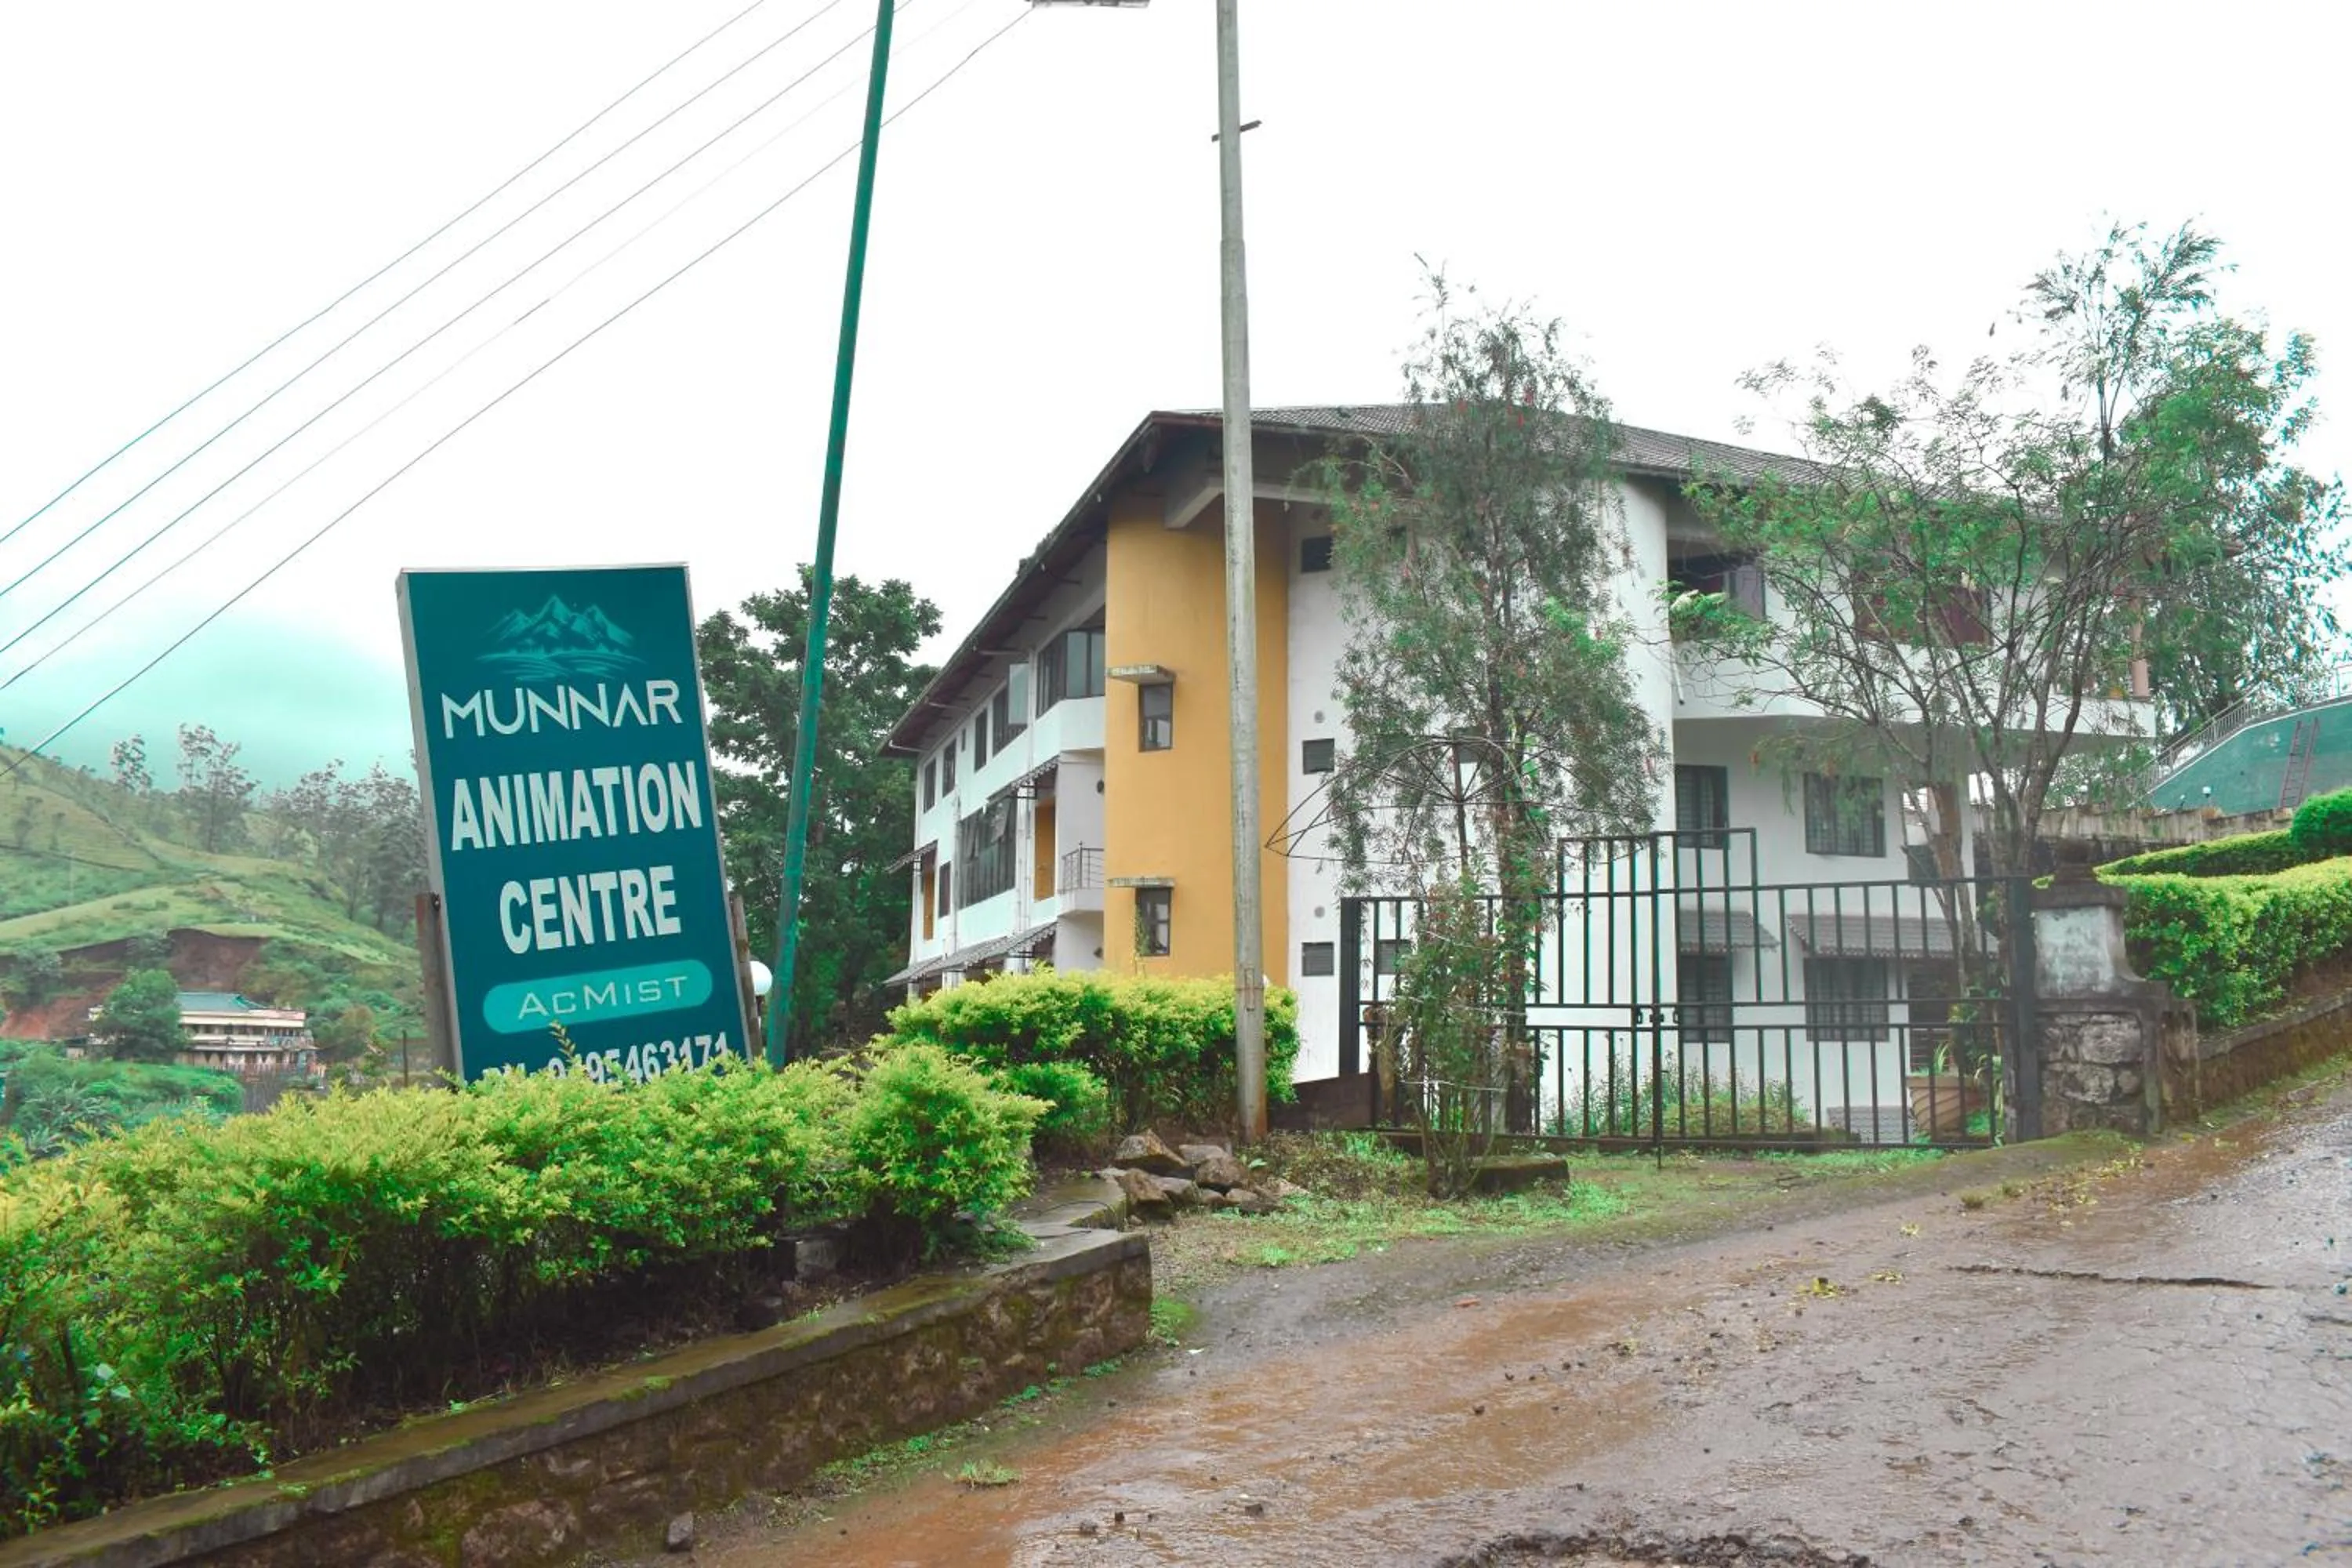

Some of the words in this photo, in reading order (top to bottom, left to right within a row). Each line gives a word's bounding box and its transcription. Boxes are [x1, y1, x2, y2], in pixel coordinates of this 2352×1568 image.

[441, 680, 683, 739] MUNNAR
[452, 760, 702, 851] ANIMATION
[499, 865, 681, 954] CENTRE
